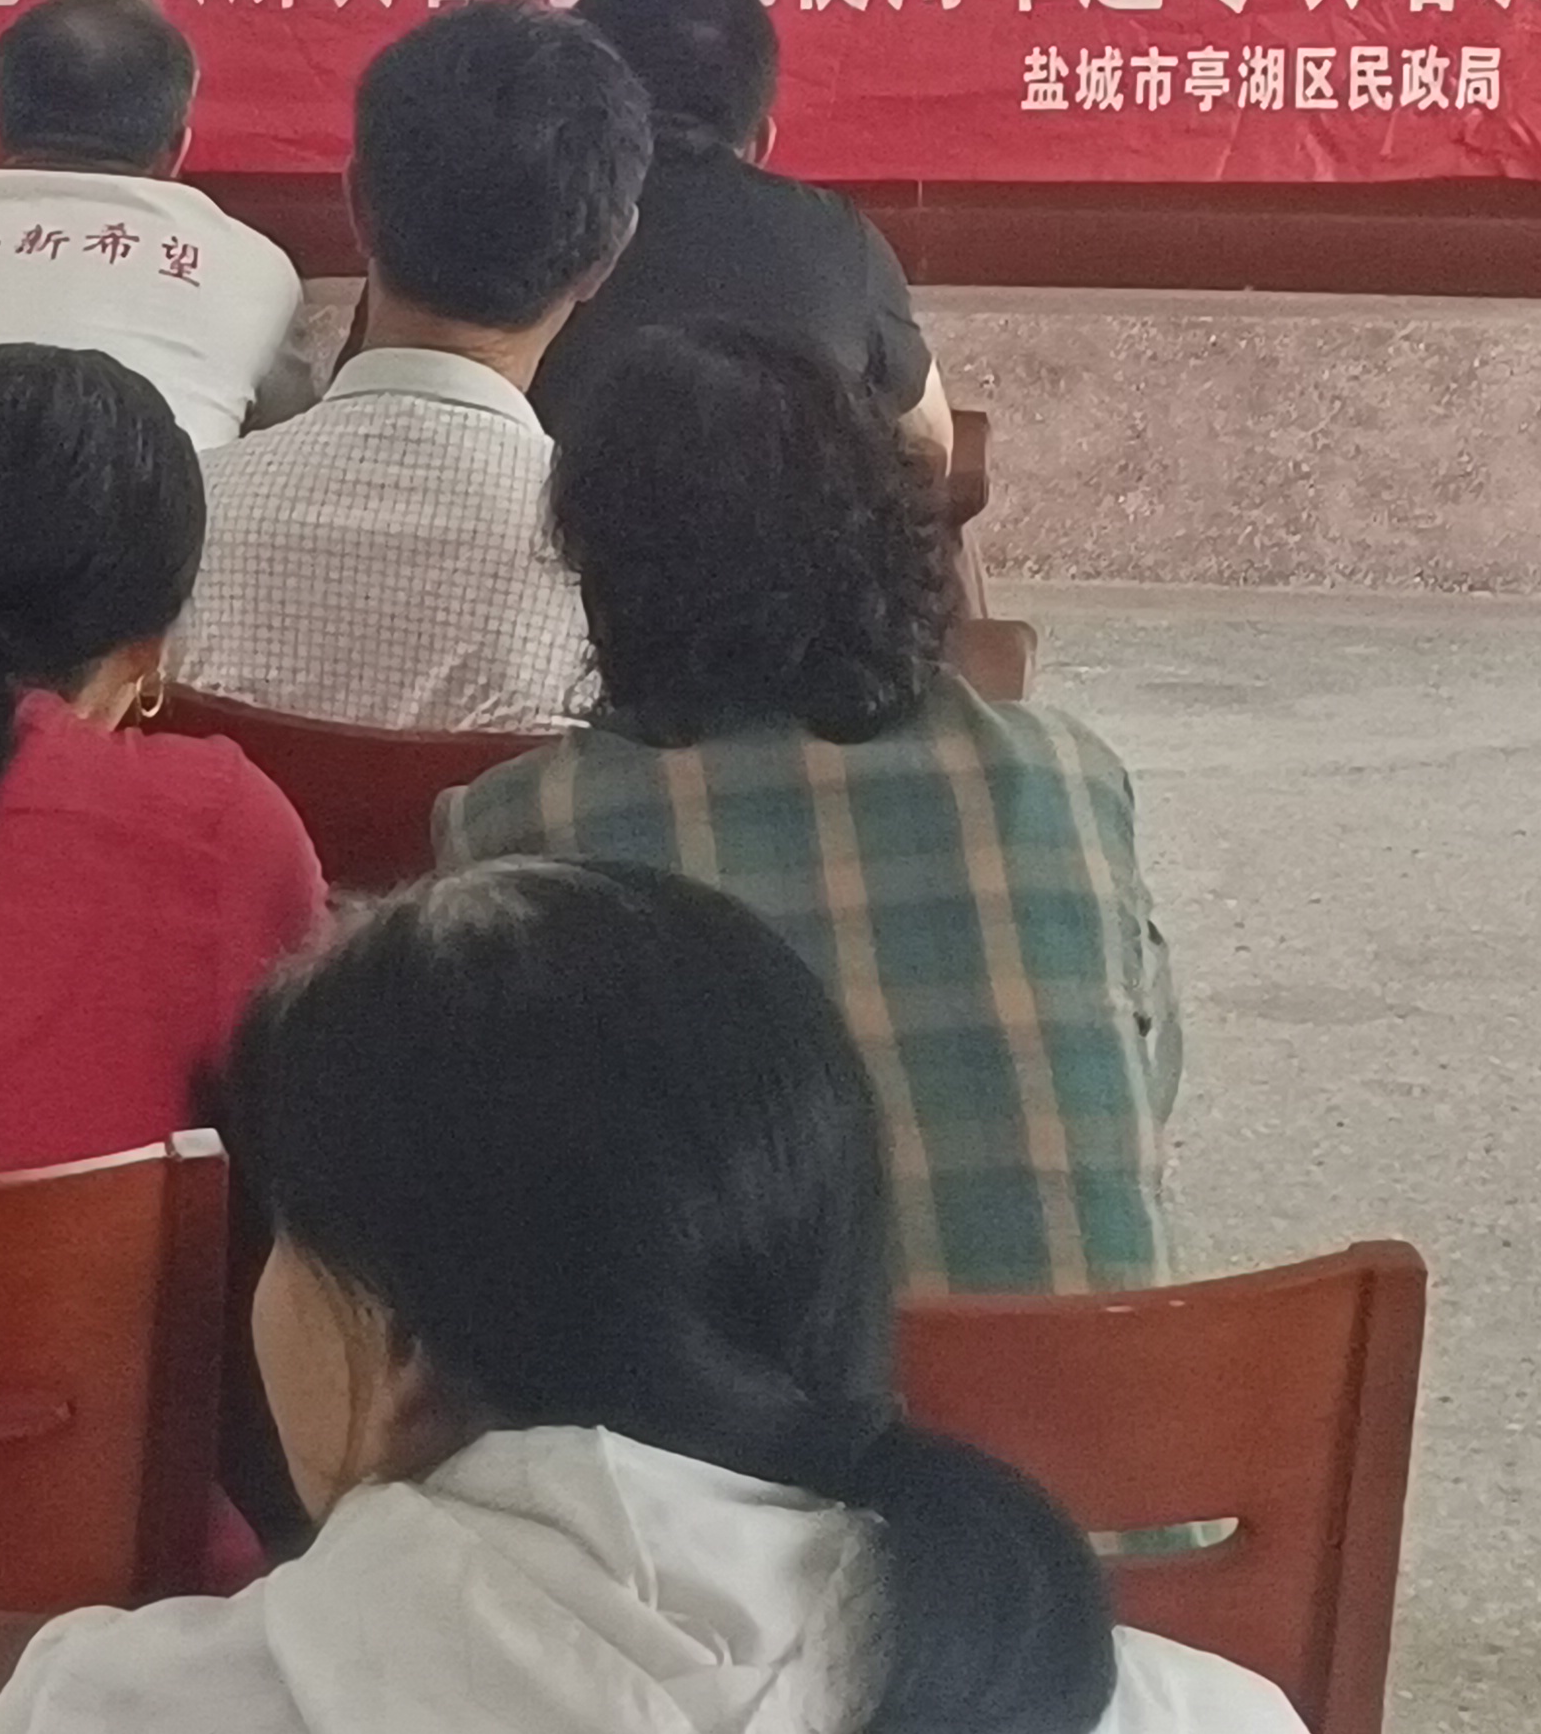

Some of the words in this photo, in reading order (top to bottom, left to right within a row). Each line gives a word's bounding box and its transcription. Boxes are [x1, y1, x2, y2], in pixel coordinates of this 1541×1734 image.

[1020, 43, 1503, 113] 盐城市亭湖区民政局
